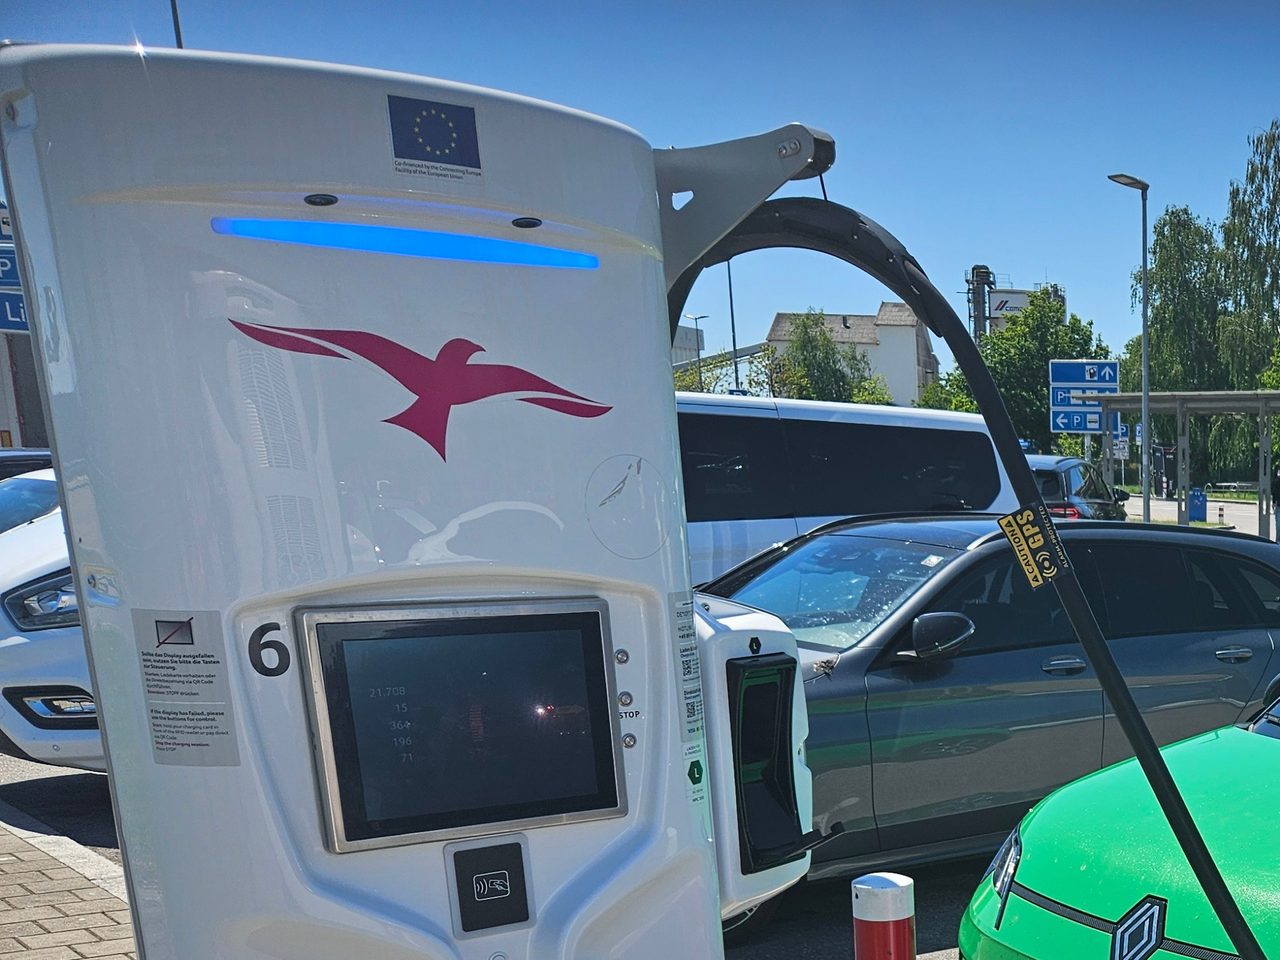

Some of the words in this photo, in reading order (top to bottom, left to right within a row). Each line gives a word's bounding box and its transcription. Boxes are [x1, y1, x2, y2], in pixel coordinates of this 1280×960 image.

[1016, 510, 1044, 549] GPS
[1008, 529, 1034, 574] CAUTION
[248, 622, 290, 677] 6
[395, 704, 408, 712] 15
[620, 710, 640, 719] STOP
